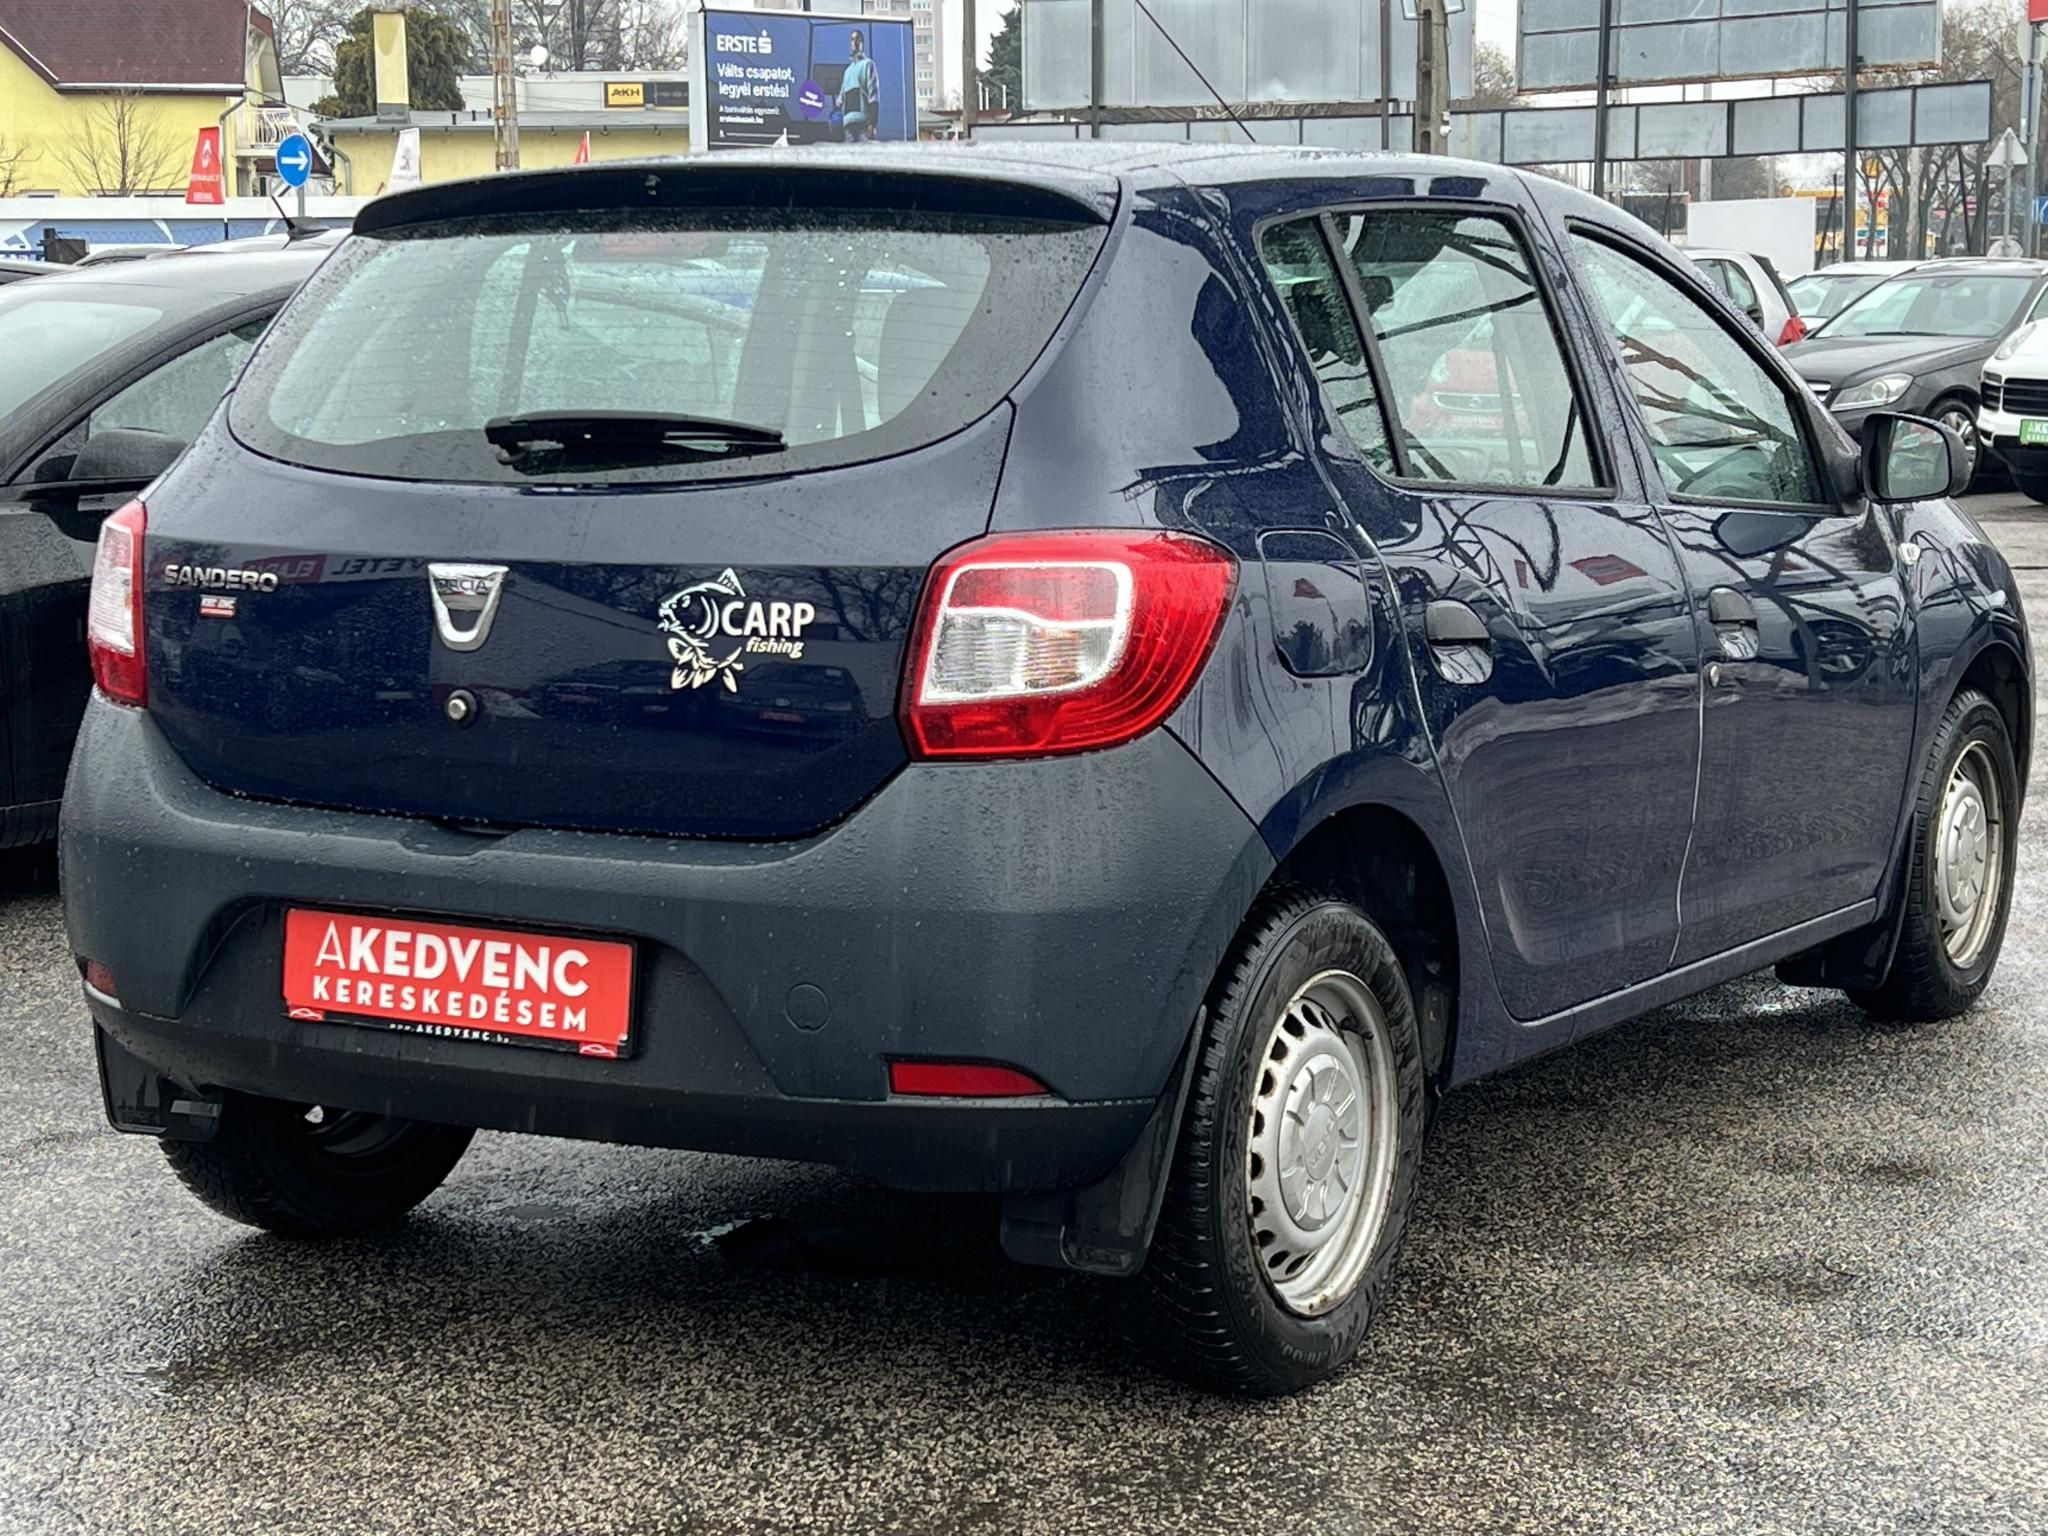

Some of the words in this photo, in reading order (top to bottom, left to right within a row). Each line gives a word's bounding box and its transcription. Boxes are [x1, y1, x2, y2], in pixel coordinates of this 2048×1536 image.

[716, 34, 758, 54] ERSTE
[716, 62, 744, 78] Válts
[746, 67, 795, 84] csapatot,
[611, 88, 640, 97] AKH
[718, 81, 752, 99] legyél
[753, 83, 790, 98] erstés!
[164, 564, 279, 593] SANDERO
[721, 601, 815, 637] CARP
[746, 638, 806, 660] fishing
[315, 920, 590, 997] AKEDVENC
[312, 975, 587, 1033] KERESKEDÉSEM
